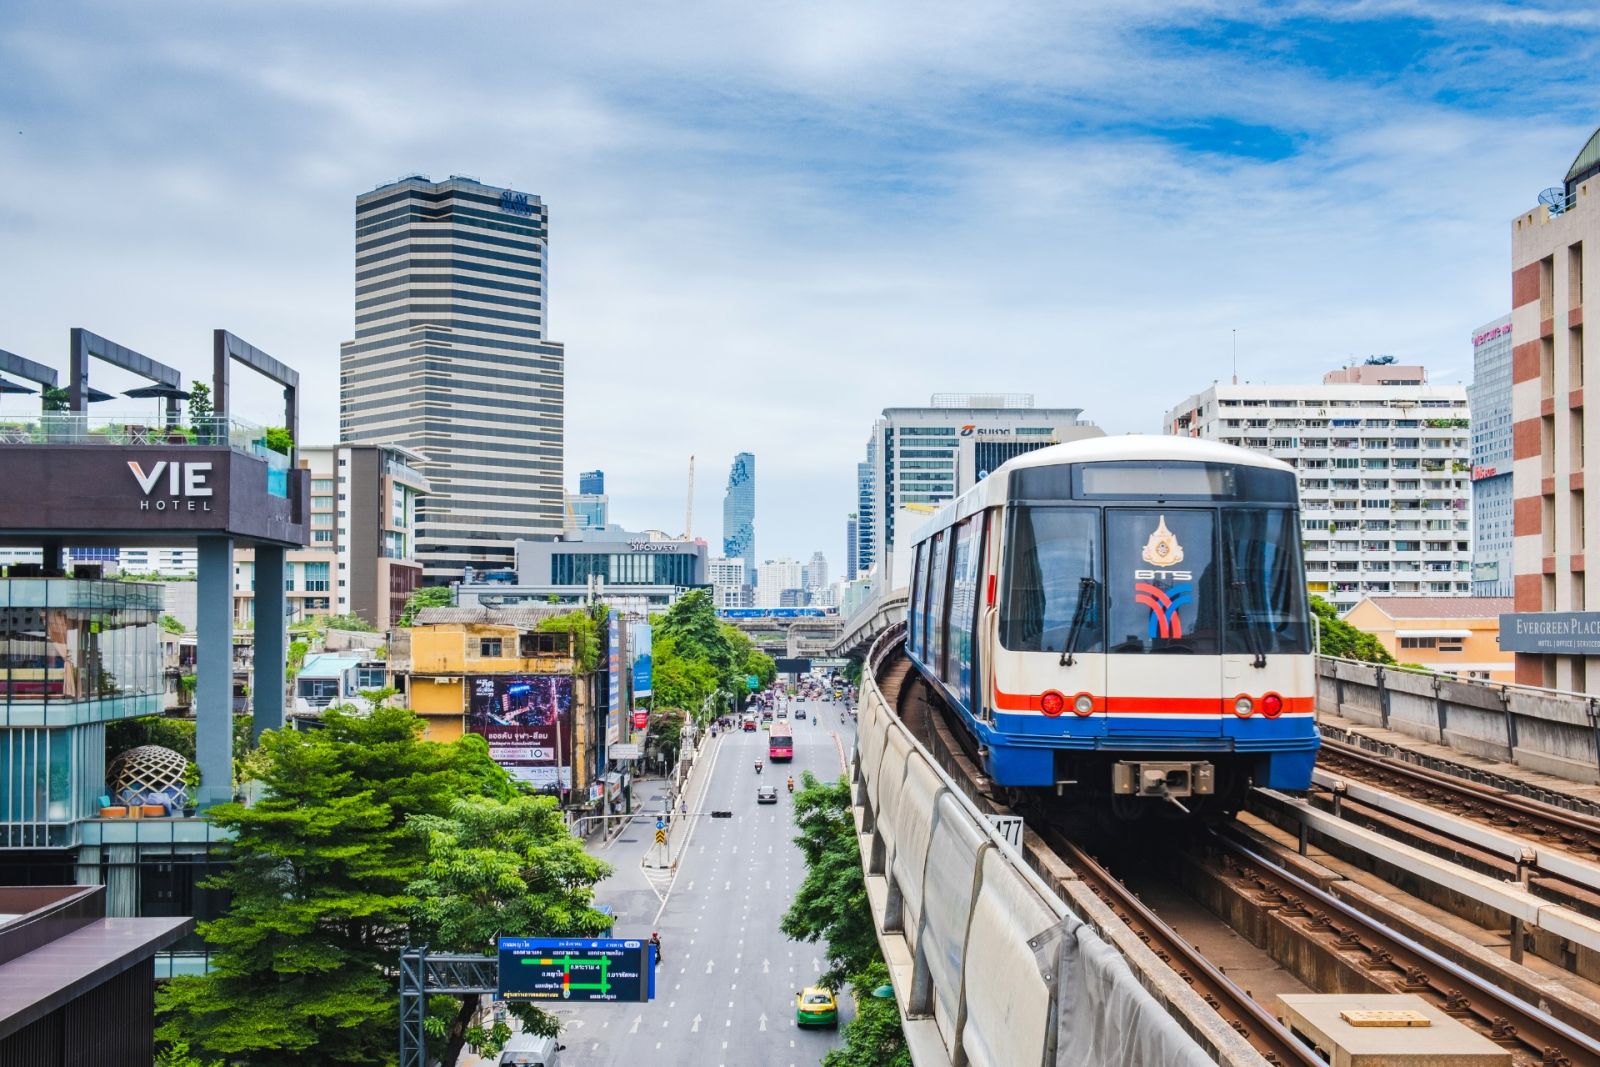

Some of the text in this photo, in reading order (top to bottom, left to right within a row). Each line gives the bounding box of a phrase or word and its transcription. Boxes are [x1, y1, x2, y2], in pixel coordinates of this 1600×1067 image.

[127, 461, 213, 496] VIE
[140, 500, 211, 511] HOTEL
[1135, 570, 1193, 581] BTS
[1516, 619, 1569, 634] EVERGREEN
[530, 749, 542, 758] 10
